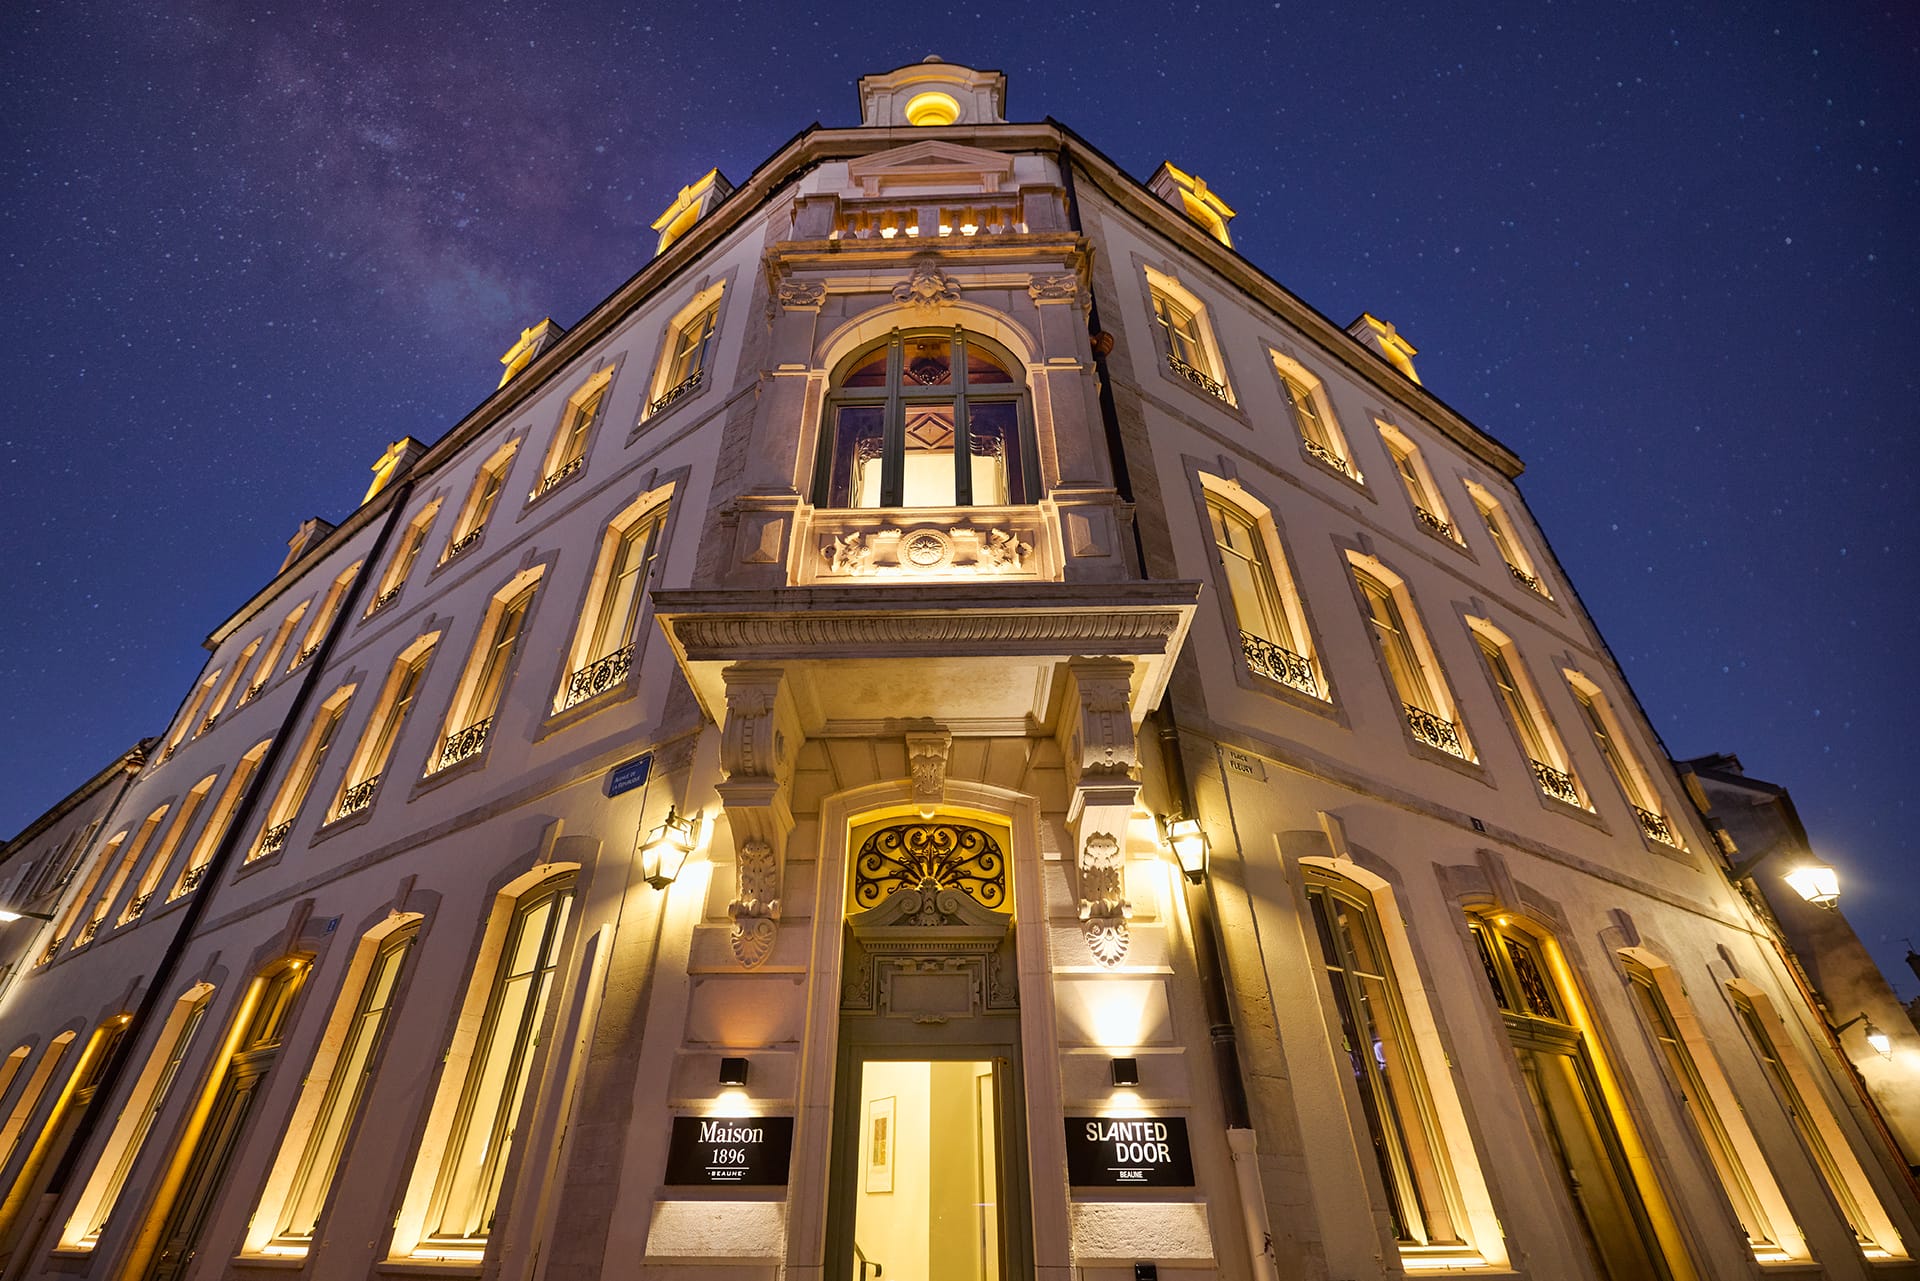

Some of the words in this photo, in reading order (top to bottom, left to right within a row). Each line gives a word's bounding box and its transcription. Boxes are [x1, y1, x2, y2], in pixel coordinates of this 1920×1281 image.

[1229, 760, 1253, 774] FLEURY
[698, 1121, 763, 1143] Maison
[1086, 1122, 1168, 1141] SLANTED
[712, 1148, 745, 1164] 1896
[1116, 1142, 1171, 1163] DOOR
